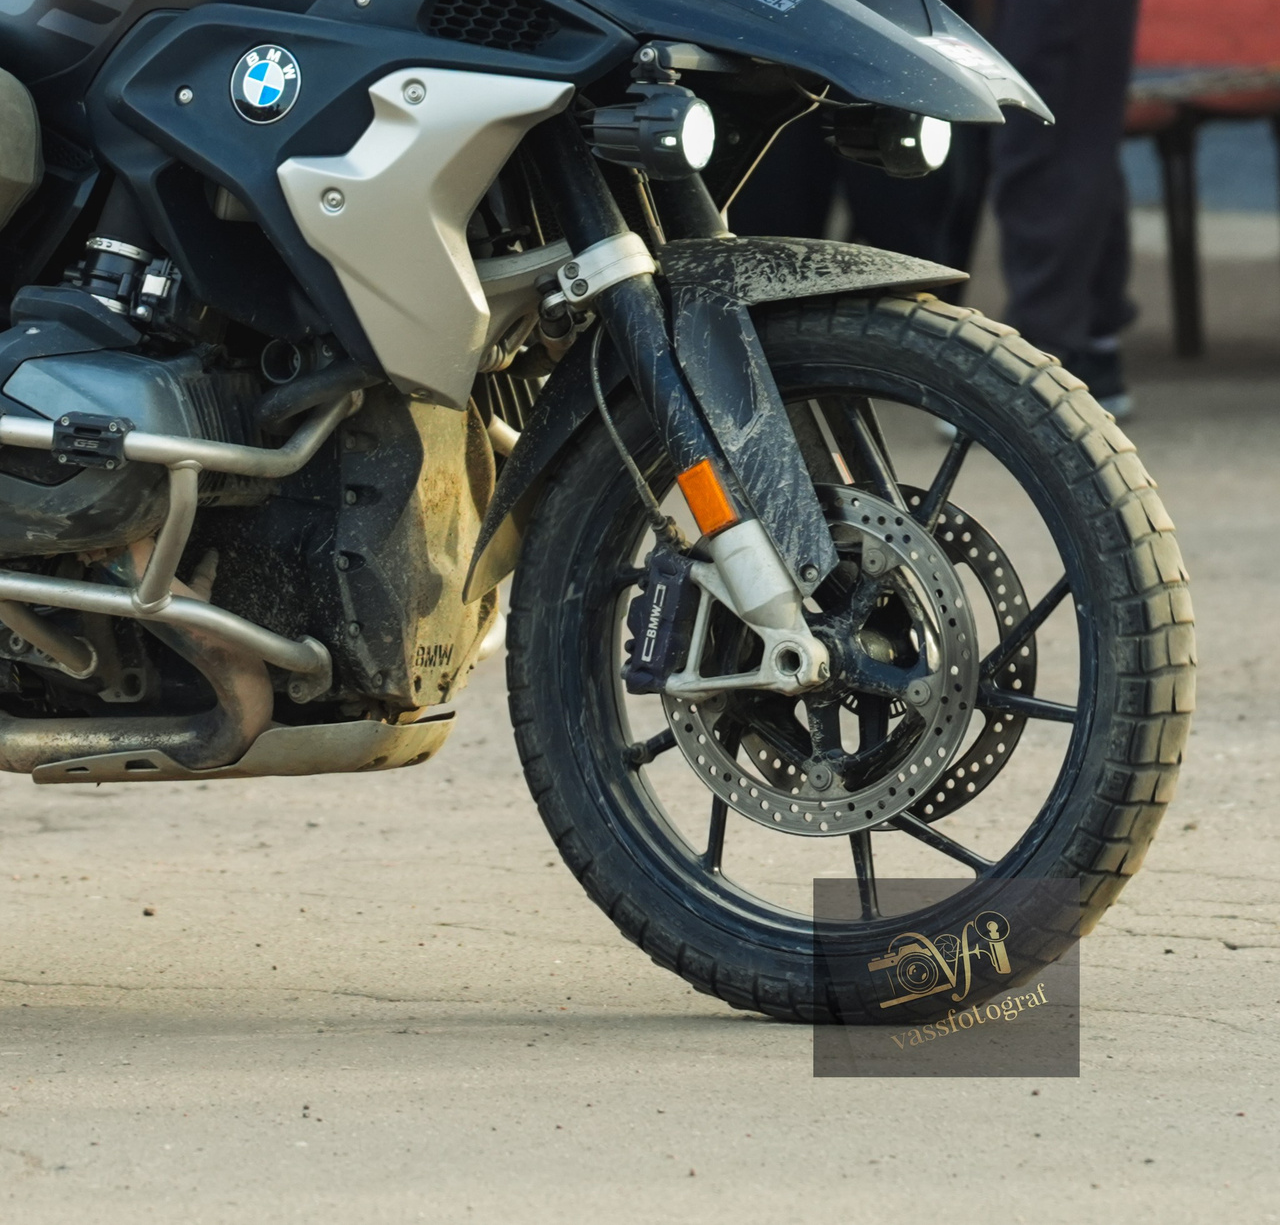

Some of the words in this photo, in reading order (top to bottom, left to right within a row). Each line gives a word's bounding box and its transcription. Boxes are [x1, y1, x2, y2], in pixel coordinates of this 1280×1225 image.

[245, 48, 296, 80] BMW
[73, 438, 100, 449] GS
[646, 604, 663, 639] BMW
[415, 643, 454, 668] BMW
